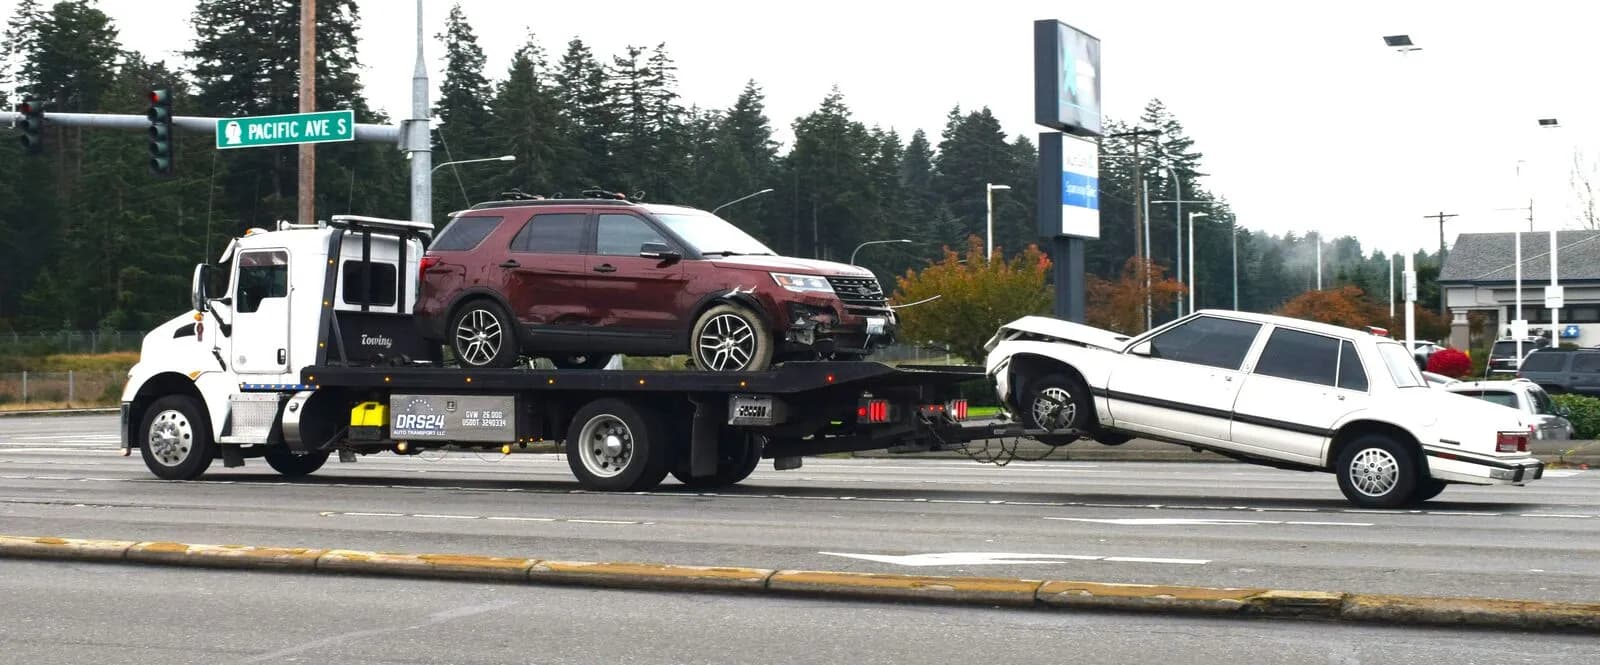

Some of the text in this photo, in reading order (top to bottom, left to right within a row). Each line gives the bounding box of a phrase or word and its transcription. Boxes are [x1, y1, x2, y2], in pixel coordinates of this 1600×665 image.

[248, 121, 299, 140] PACIFIC
[305, 119, 330, 137] AVE
[337, 118, 346, 135] S
[361, 334, 392, 348] Towing
[396, 415, 445, 429] DRS24
